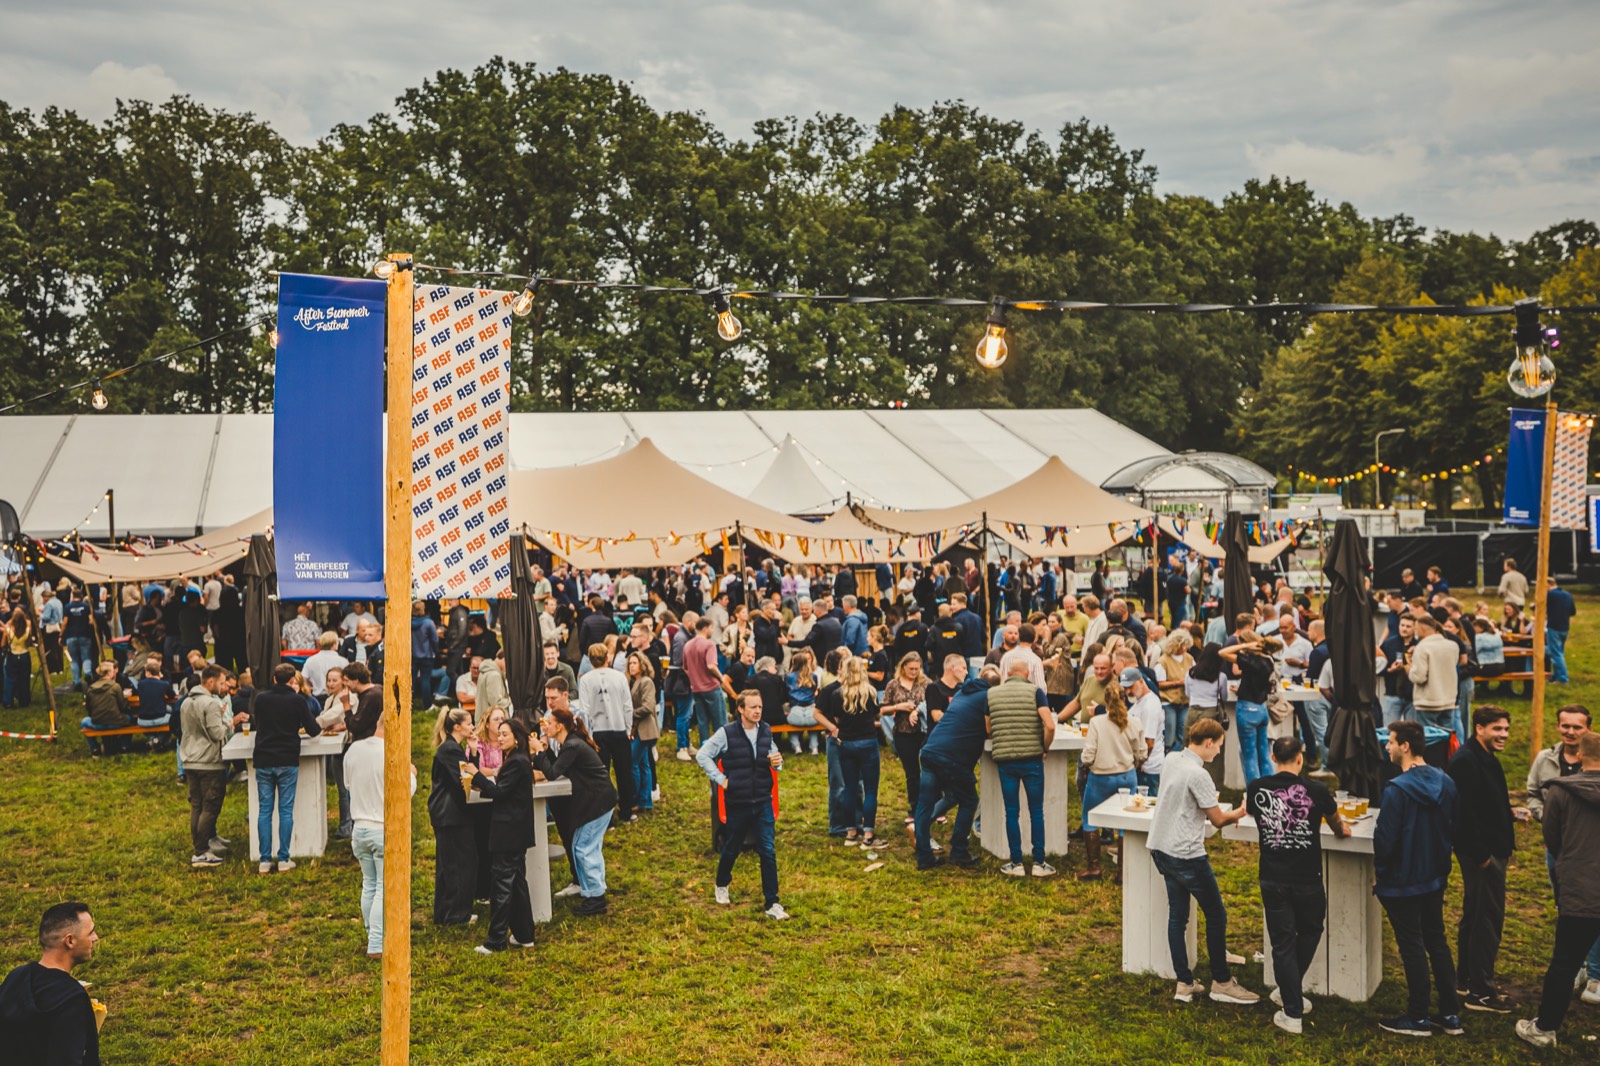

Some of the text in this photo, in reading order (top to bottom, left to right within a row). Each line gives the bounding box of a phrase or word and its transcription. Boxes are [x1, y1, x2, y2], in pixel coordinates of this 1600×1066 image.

[294, 306, 370, 326] After Summer
[316, 319, 349, 331] Festival
[414, 296, 425, 312] SF
[414, 319, 426, 336] SF
[430, 305, 450, 325] ASF
[454, 292, 474, 311] ASF
[414, 300, 498, 360] SF ASF ASF ASF
[431, 350, 451, 370] ASF
[455, 336, 475, 356] ASF
[478, 322, 498, 342] ASF
[432, 372, 452, 392] ASF
[456, 358, 476, 378] ASF
[480, 344, 499, 364] ASF
[412, 409, 430, 429] ASF
[432, 394, 453, 415] ASF
[456, 380, 477, 400] ASF
[480, 366, 500, 386] ASF
[434, 416, 454, 436] ASF
[457, 402, 477, 422] ASF
[481, 388, 501, 408] ASF
[412, 410, 502, 474] ASF ASF ASF ASF
[412, 432, 504, 496] ASF ASF ASF ASF
[412, 454, 504, 518] ASF ASF ASF ASF
[415, 474, 506, 540] ASF ASF ASF ASF
[418, 496, 508, 562] ASF ASF ASF ASF
[421, 564, 442, 584] ASF
[444, 548, 464, 568] ASF
[466, 533, 486, 554] ASF
[490, 518, 510, 538] ASF
[294, 562, 350, 570] ZOMERFEEST
[296, 571, 349, 579] VAN RIJSSEN
[447, 570, 467, 590] ASF
[469, 554, 489, 575] ASF
[491, 540, 510, 560] ASF
[472, 576, 492, 596] ASF
